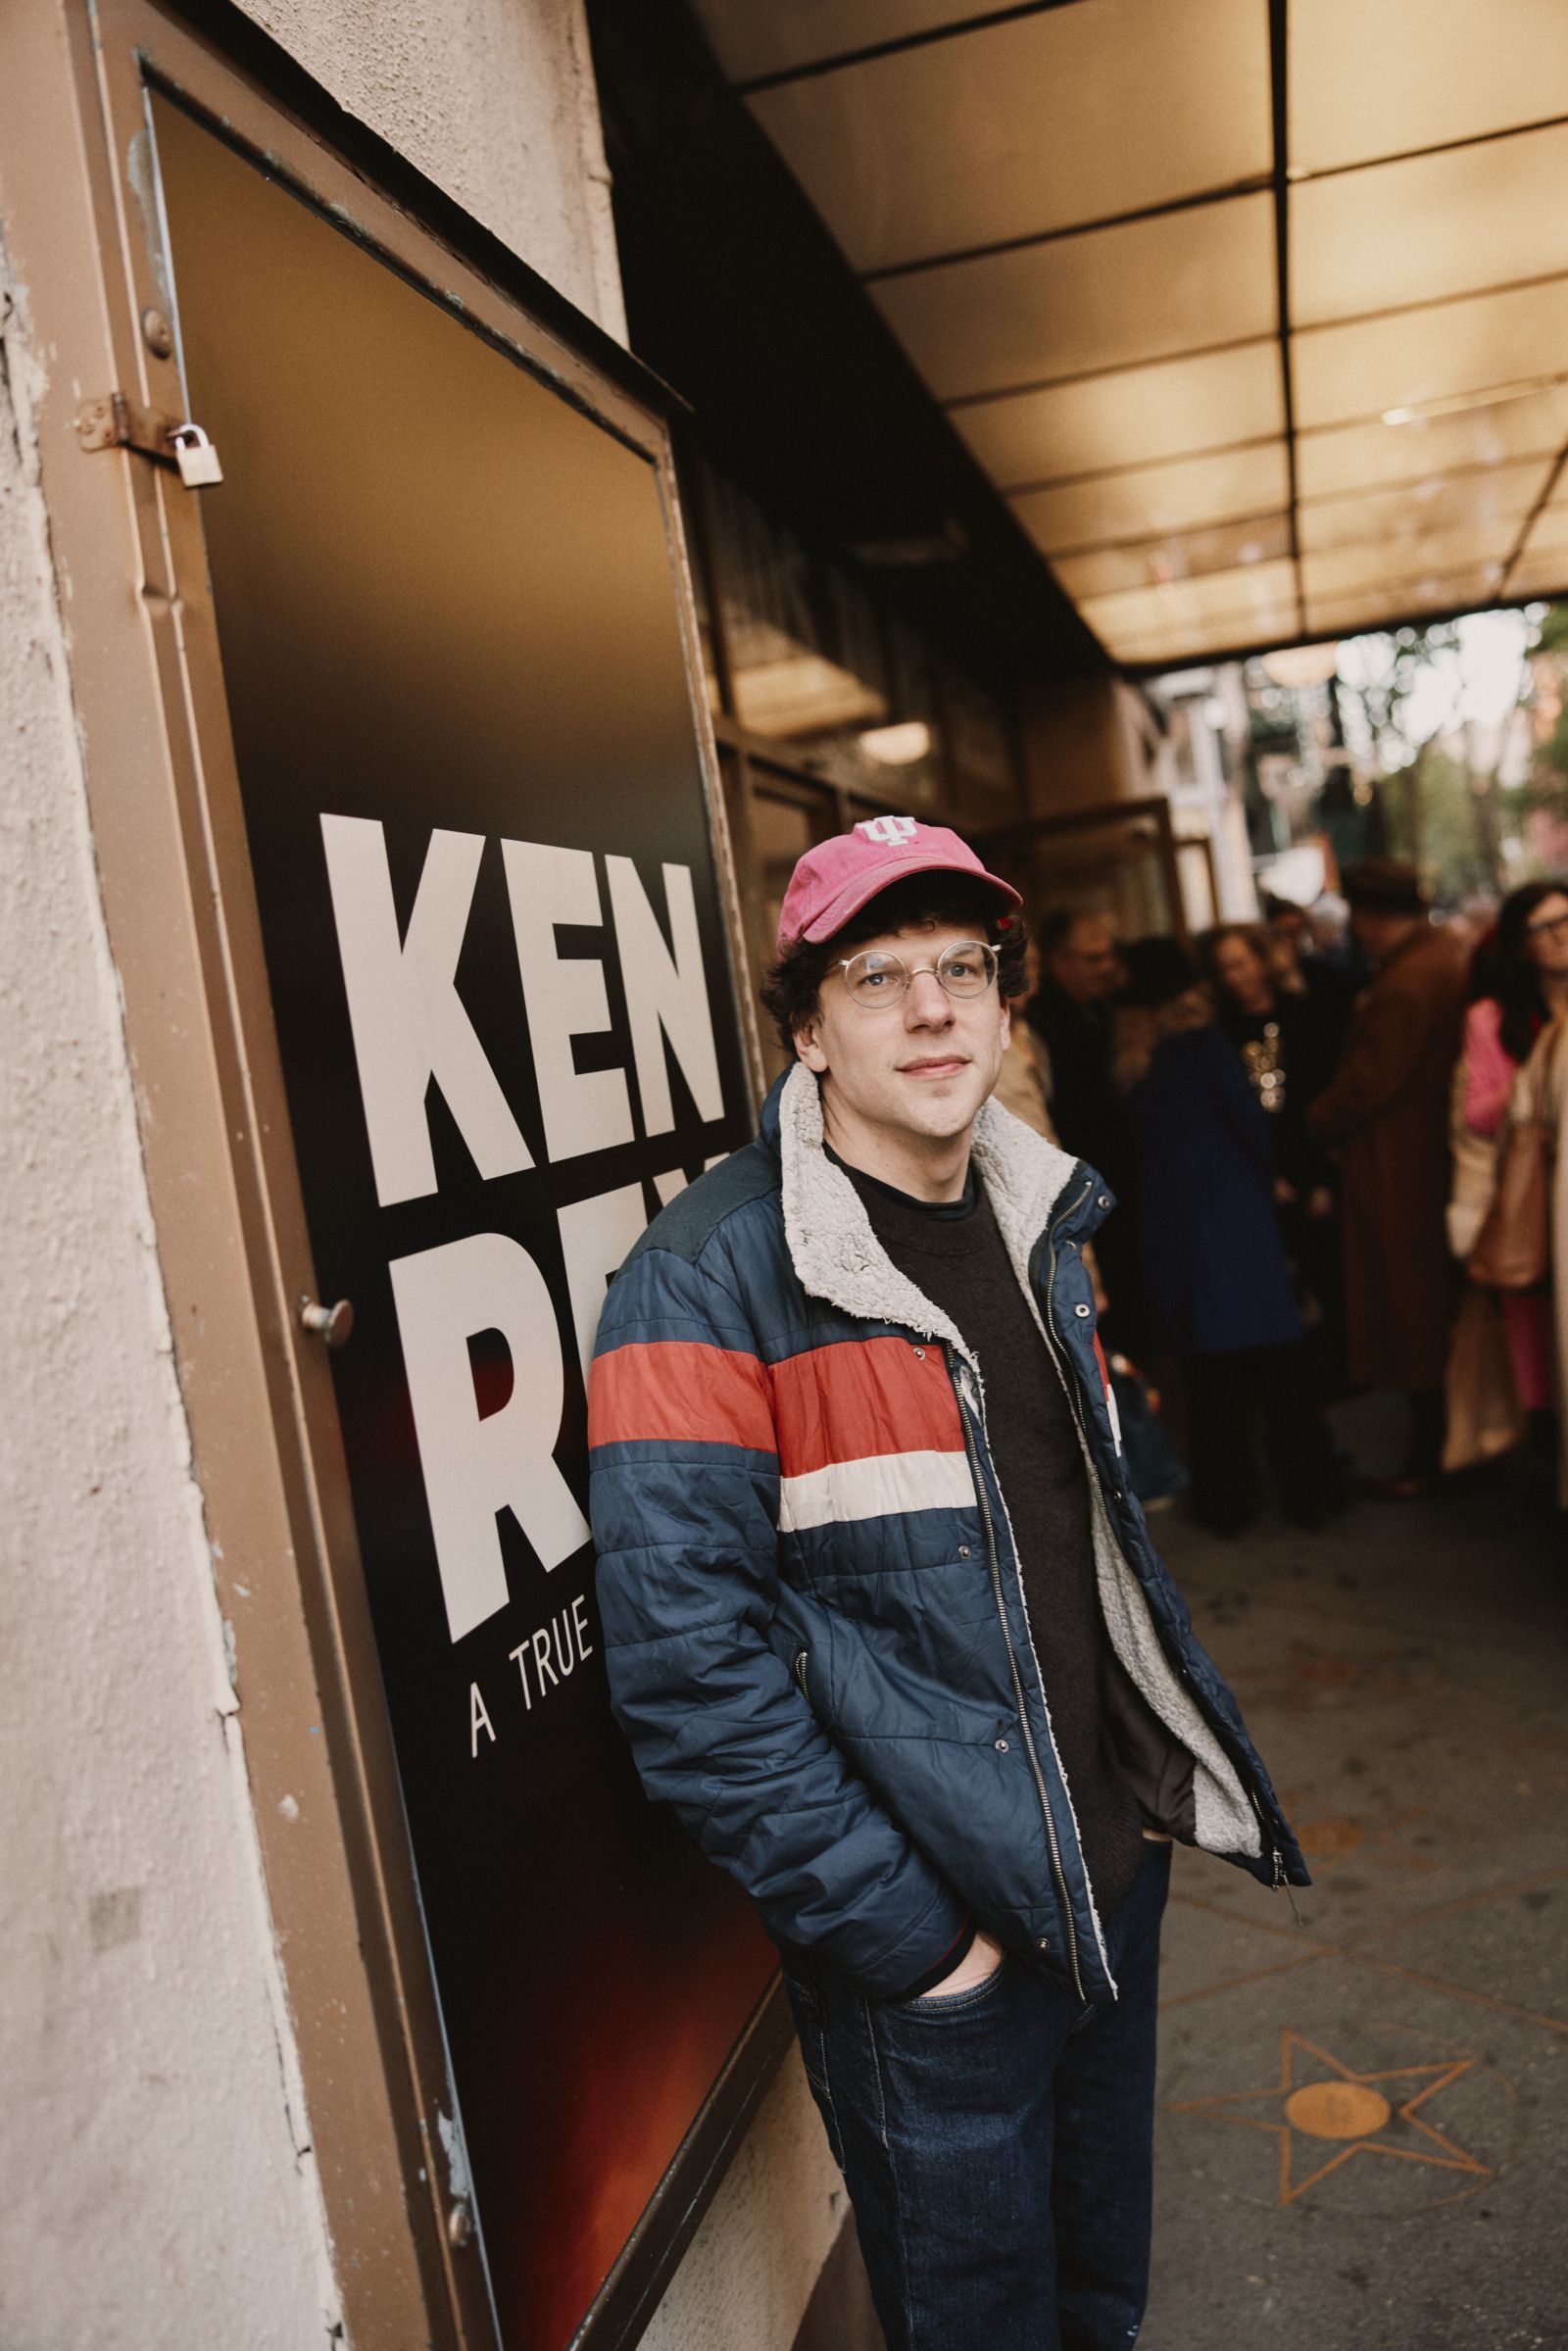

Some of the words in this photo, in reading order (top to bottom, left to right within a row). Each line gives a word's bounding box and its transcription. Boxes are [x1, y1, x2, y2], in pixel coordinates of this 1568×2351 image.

[319, 812, 725, 1207] KEN
[470, 1681, 497, 1758] A
[509, 1593, 594, 1710] TRUE
